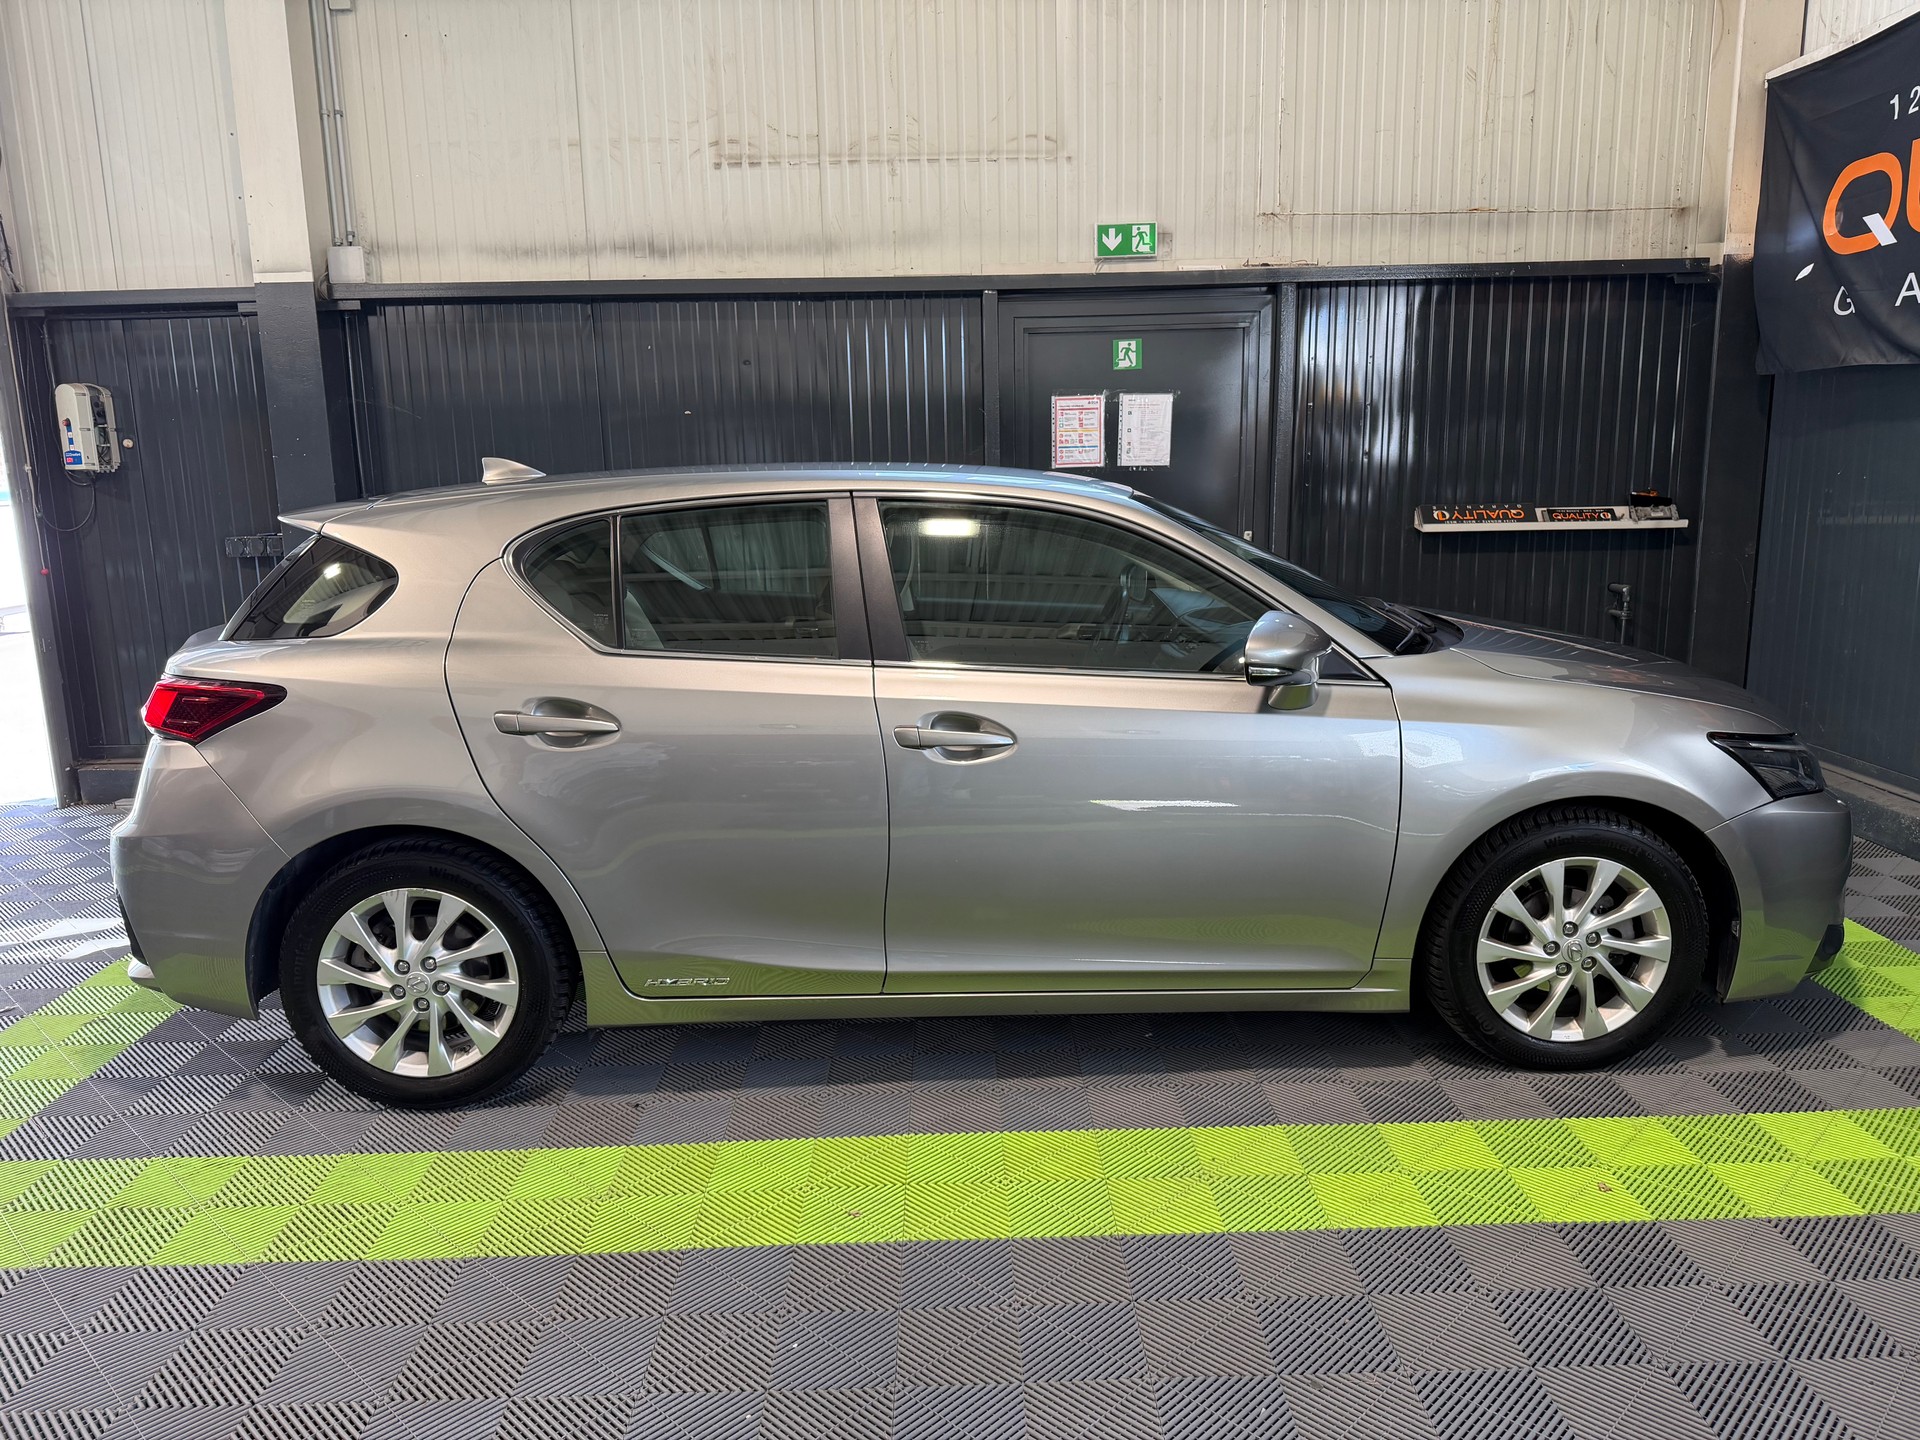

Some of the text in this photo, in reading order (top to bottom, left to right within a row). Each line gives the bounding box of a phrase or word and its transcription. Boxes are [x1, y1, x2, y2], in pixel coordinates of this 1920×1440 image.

[1822, 138, 1920, 255] Q
[1452, 509, 1525, 521] QUALITY
[1552, 512, 1598, 520] QUALITY
[644, 977, 730, 987] HYBRID
